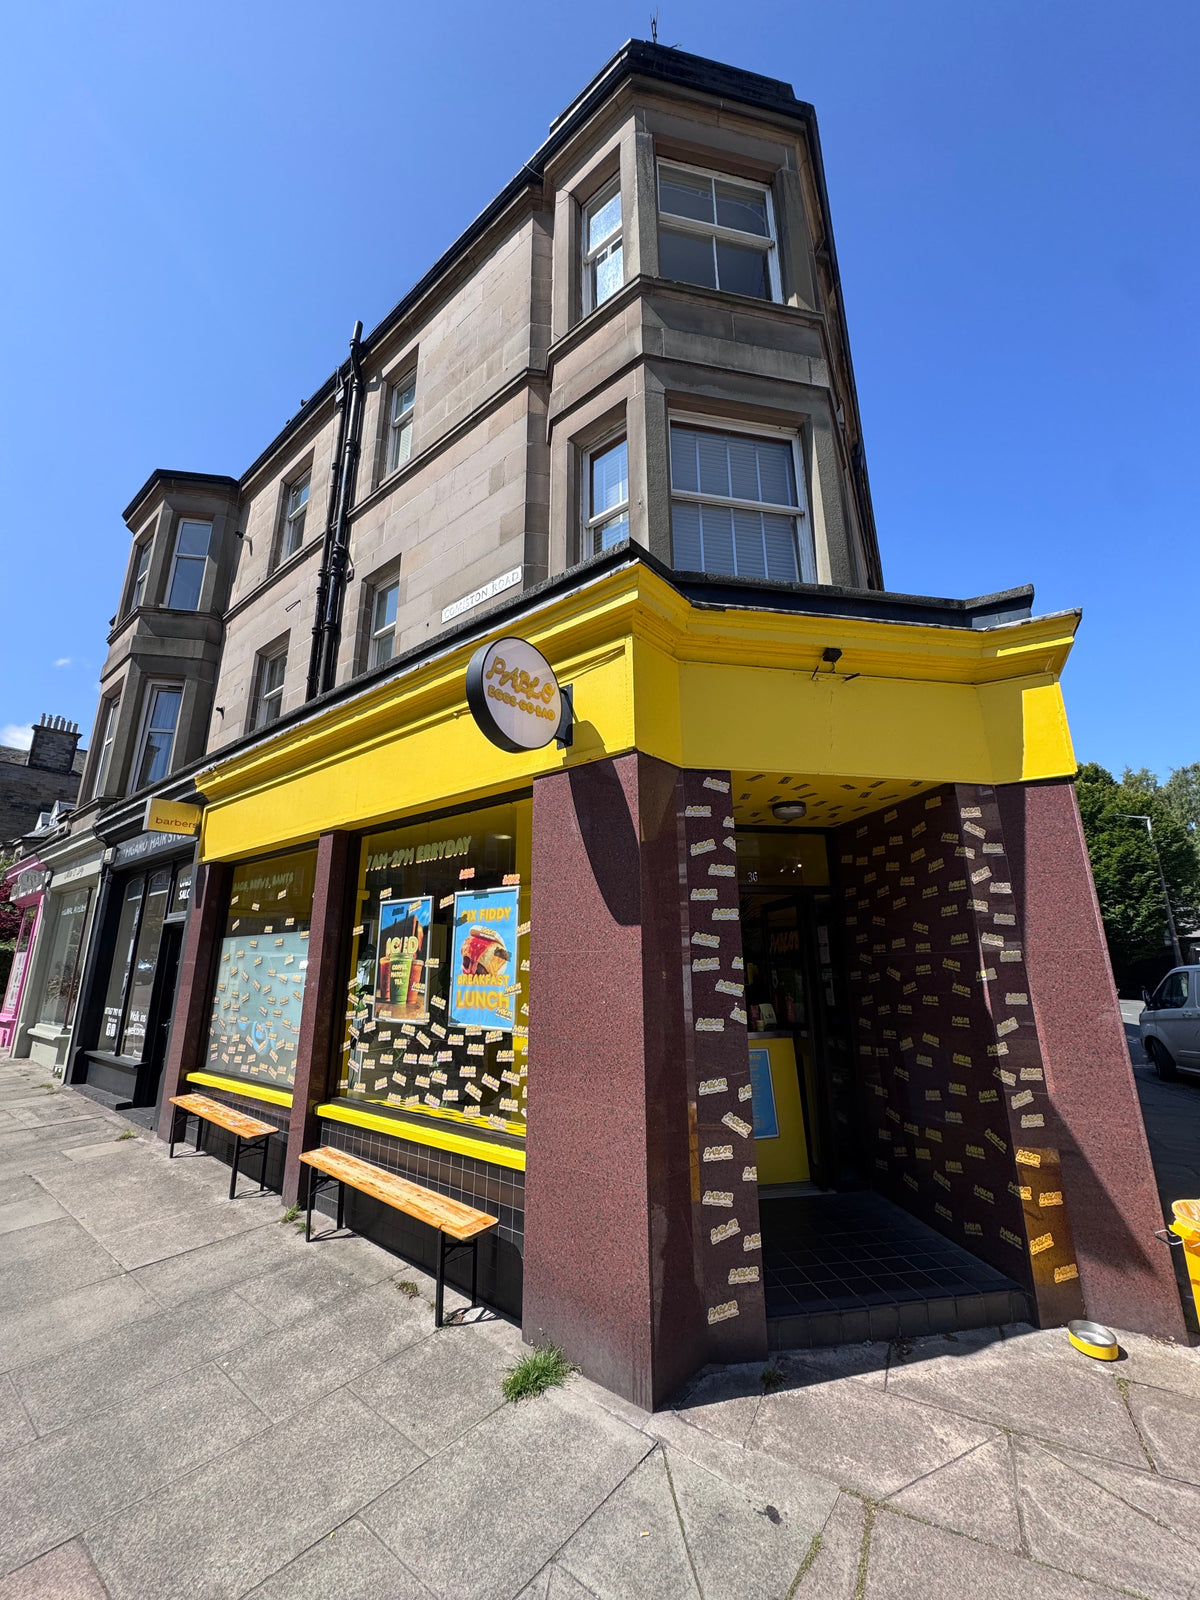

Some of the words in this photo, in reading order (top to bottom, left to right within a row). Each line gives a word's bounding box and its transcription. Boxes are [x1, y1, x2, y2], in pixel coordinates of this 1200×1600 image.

[444, 588, 488, 618] COMISTON
[492, 571, 519, 594] ROAD
[155, 817, 198, 829] barbers
[366, 847, 414, 872] 7AM-2PM
[416, 836, 472, 863] ERRYDAY
[747, 872, 758, 882] 36
[478, 906, 512, 922] FIDDY
[386, 936, 418, 956] ICED
[457, 974, 509, 986] BREAKFAST
[456, 990, 509, 1011] LUNCH
